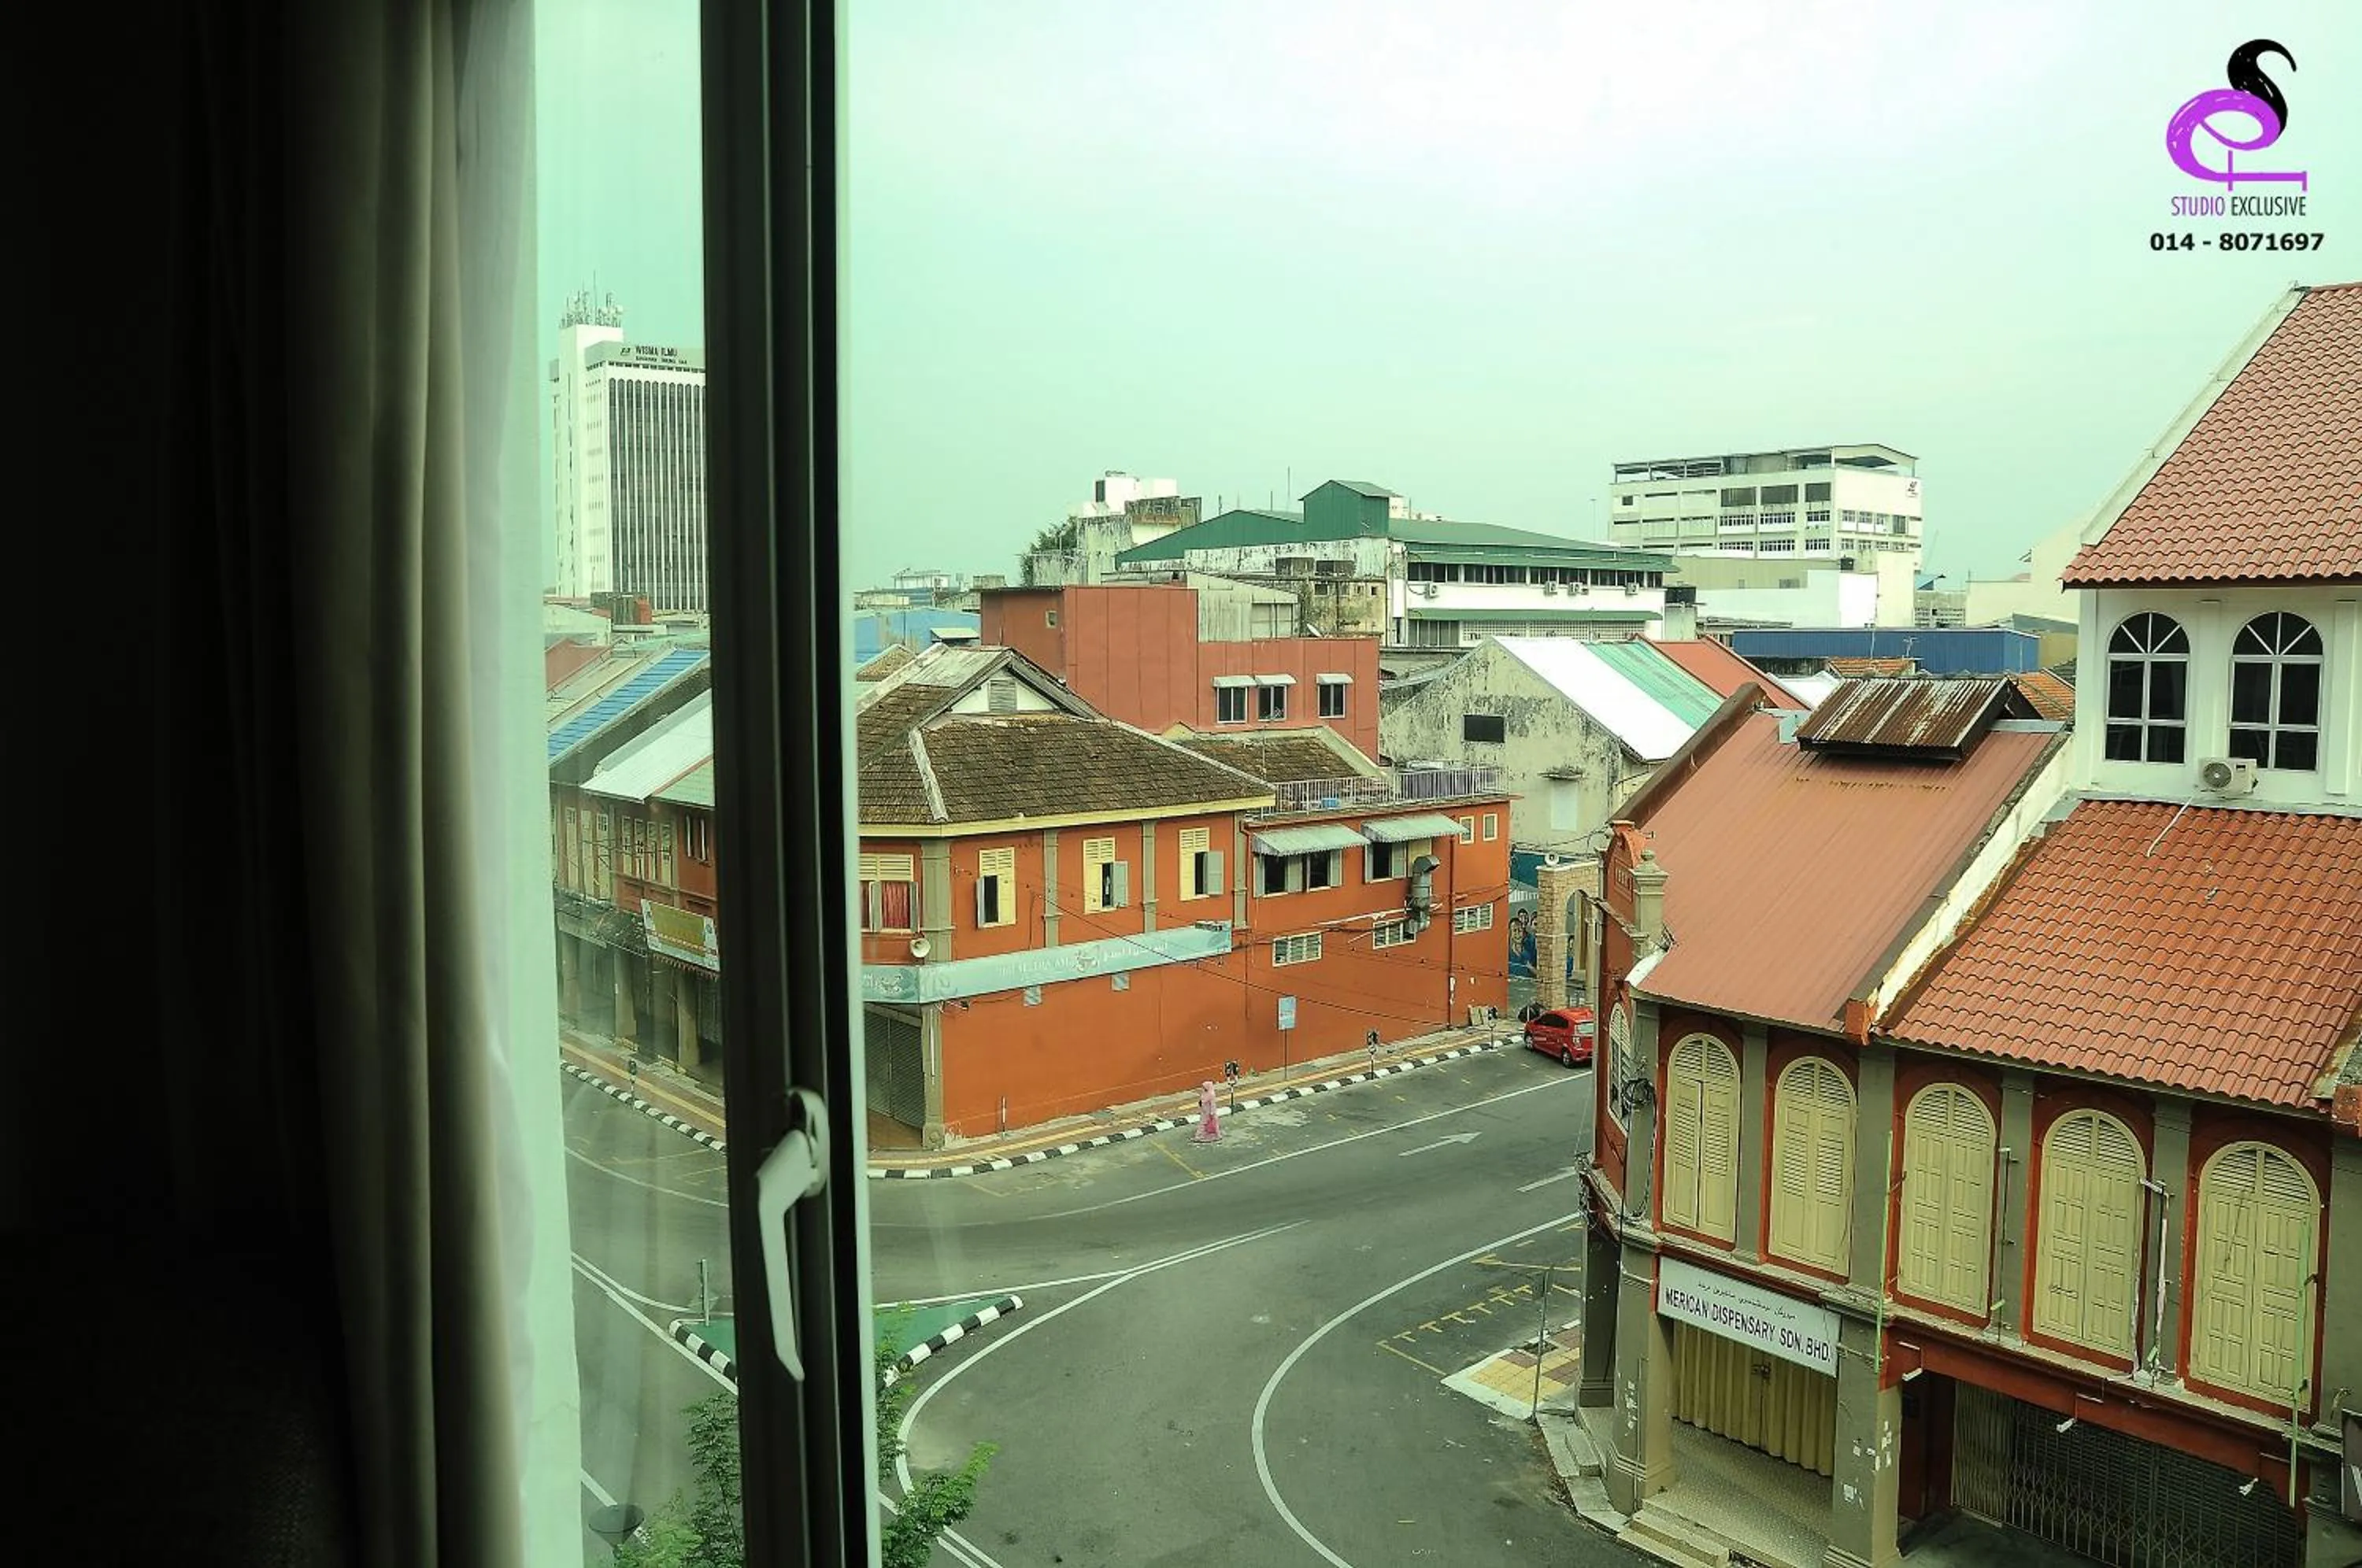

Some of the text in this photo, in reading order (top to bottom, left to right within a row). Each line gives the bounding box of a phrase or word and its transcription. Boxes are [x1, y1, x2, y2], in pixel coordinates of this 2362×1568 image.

[1665, 1287, 1709, 1319] MERICAN
[1712, 1303, 1776, 1342] DISPENSARY
[1779, 1327, 1805, 1354] SDN.
[1805, 1337, 1831, 1363] BHD.
